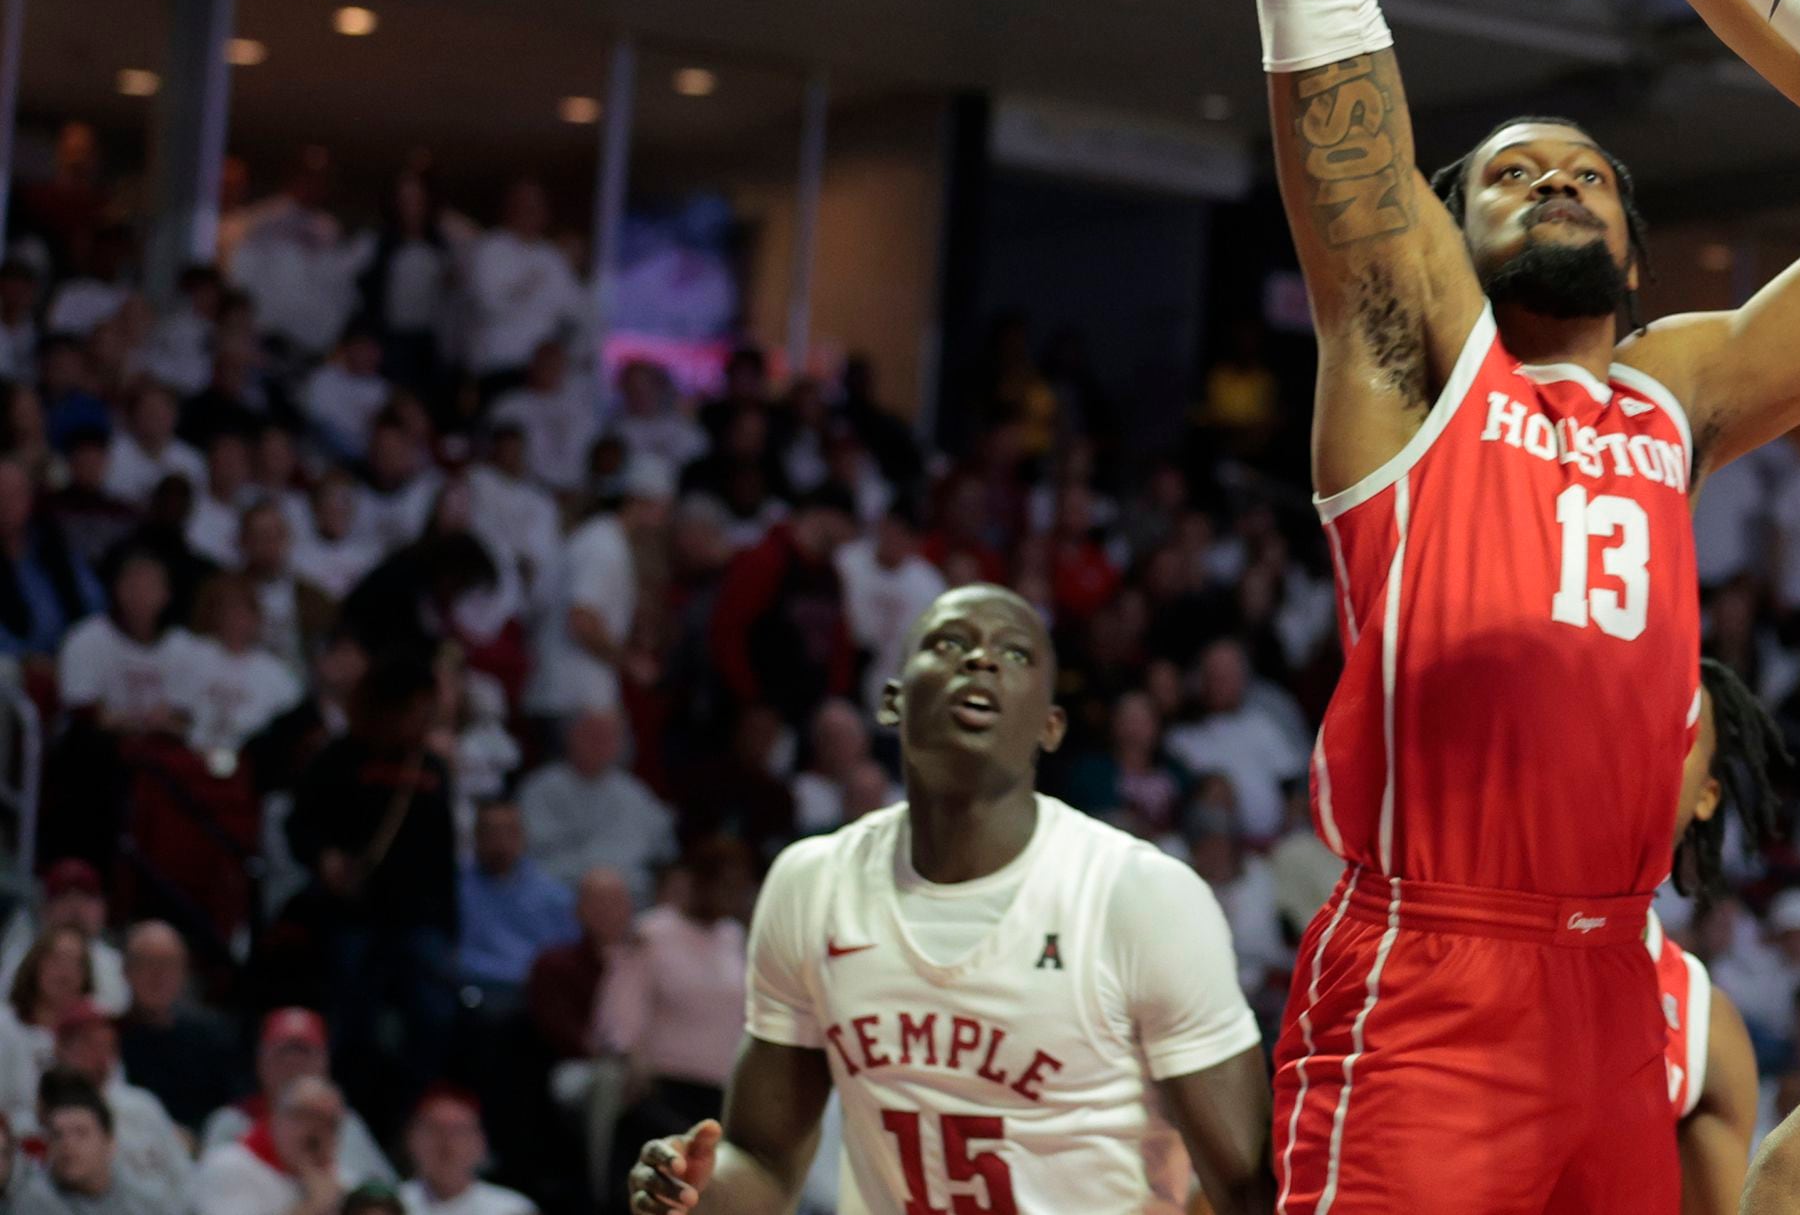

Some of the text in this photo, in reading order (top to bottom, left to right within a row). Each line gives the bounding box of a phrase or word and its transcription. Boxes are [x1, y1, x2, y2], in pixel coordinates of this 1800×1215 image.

[1480, 390, 1686, 495] HOUSTON
[1551, 483, 1650, 642] 13
[826, 1012, 1064, 1102] TEMPLE
[881, 1107, 1019, 1215] 15
